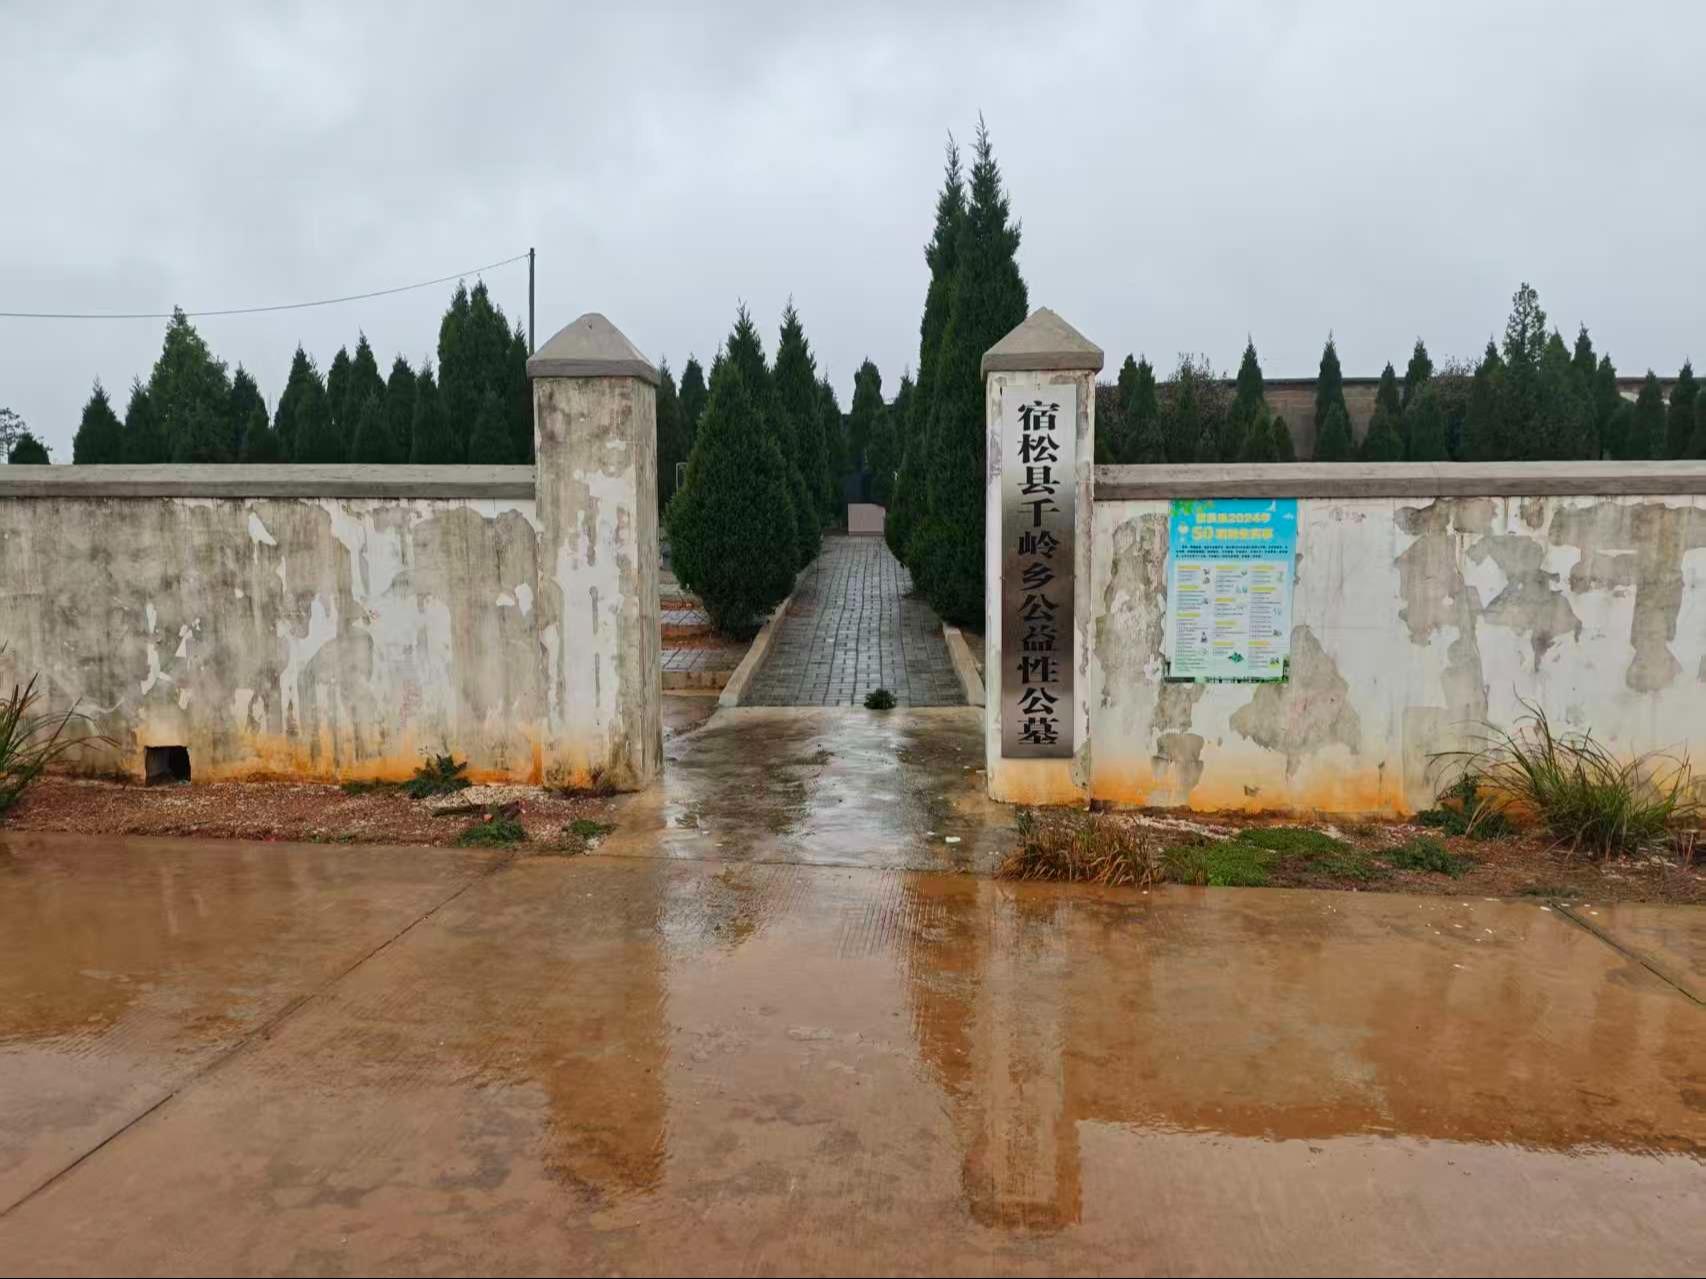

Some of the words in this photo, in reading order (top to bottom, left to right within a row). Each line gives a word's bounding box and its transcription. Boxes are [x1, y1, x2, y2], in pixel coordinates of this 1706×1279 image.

[1018, 401, 1060, 744] 宿松县千岭乡公益性公墓
